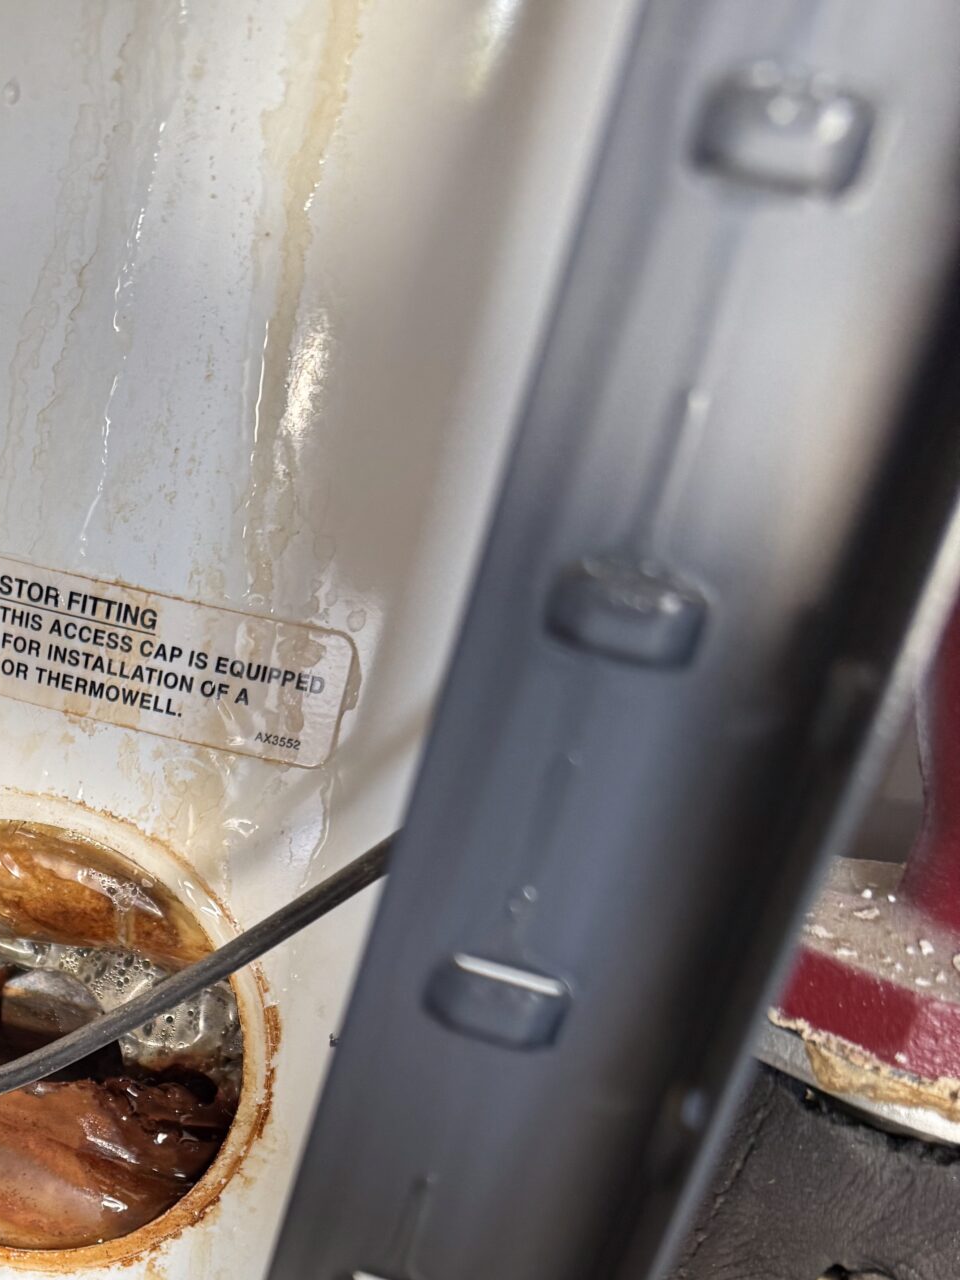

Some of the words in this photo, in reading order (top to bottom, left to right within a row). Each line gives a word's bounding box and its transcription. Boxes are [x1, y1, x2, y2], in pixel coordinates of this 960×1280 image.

[67, 591, 158, 630] FITTING
[0, 606, 43, 632] THIS
[49, 619, 133, 653] ACCESS
[140, 640, 183, 667] CAP
[188, 650, 209, 670] IS
[214, 657, 326, 695] EQUIPPED
[1, 633, 42, 658] FOR
[47, 643, 195, 694] INSTALLATION
[200, 680, 230, 703] OF
[234, 687, 250, 706] A
[1, 659, 29, 681] OR
[36, 666, 183, 717] THERMOWELL.
[254, 731, 302, 751] AX3552
